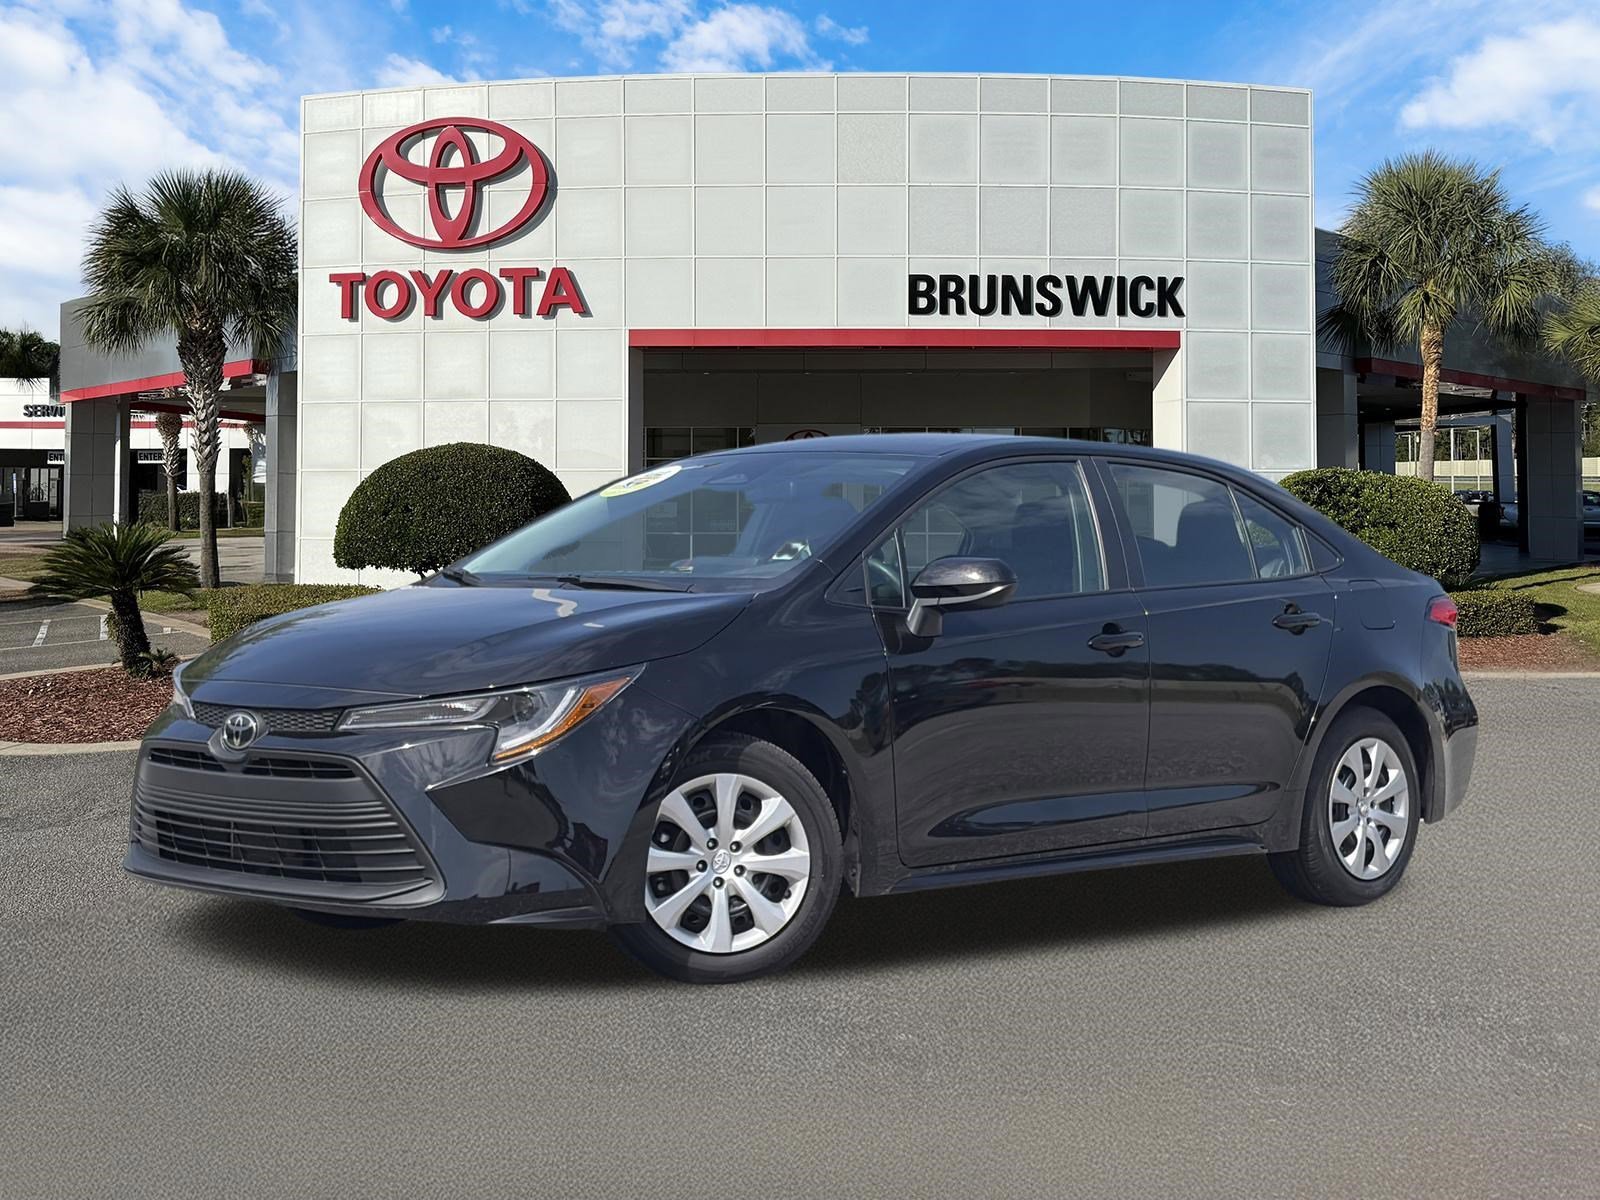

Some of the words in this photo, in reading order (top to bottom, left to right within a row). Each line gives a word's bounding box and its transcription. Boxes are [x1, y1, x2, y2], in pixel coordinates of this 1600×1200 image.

[329, 267, 587, 319] TOYOTA
[908, 274, 1185, 317] BRUNSWICK
[23, 404, 65, 417] SERVI
[48, 452, 64, 461] ENT
